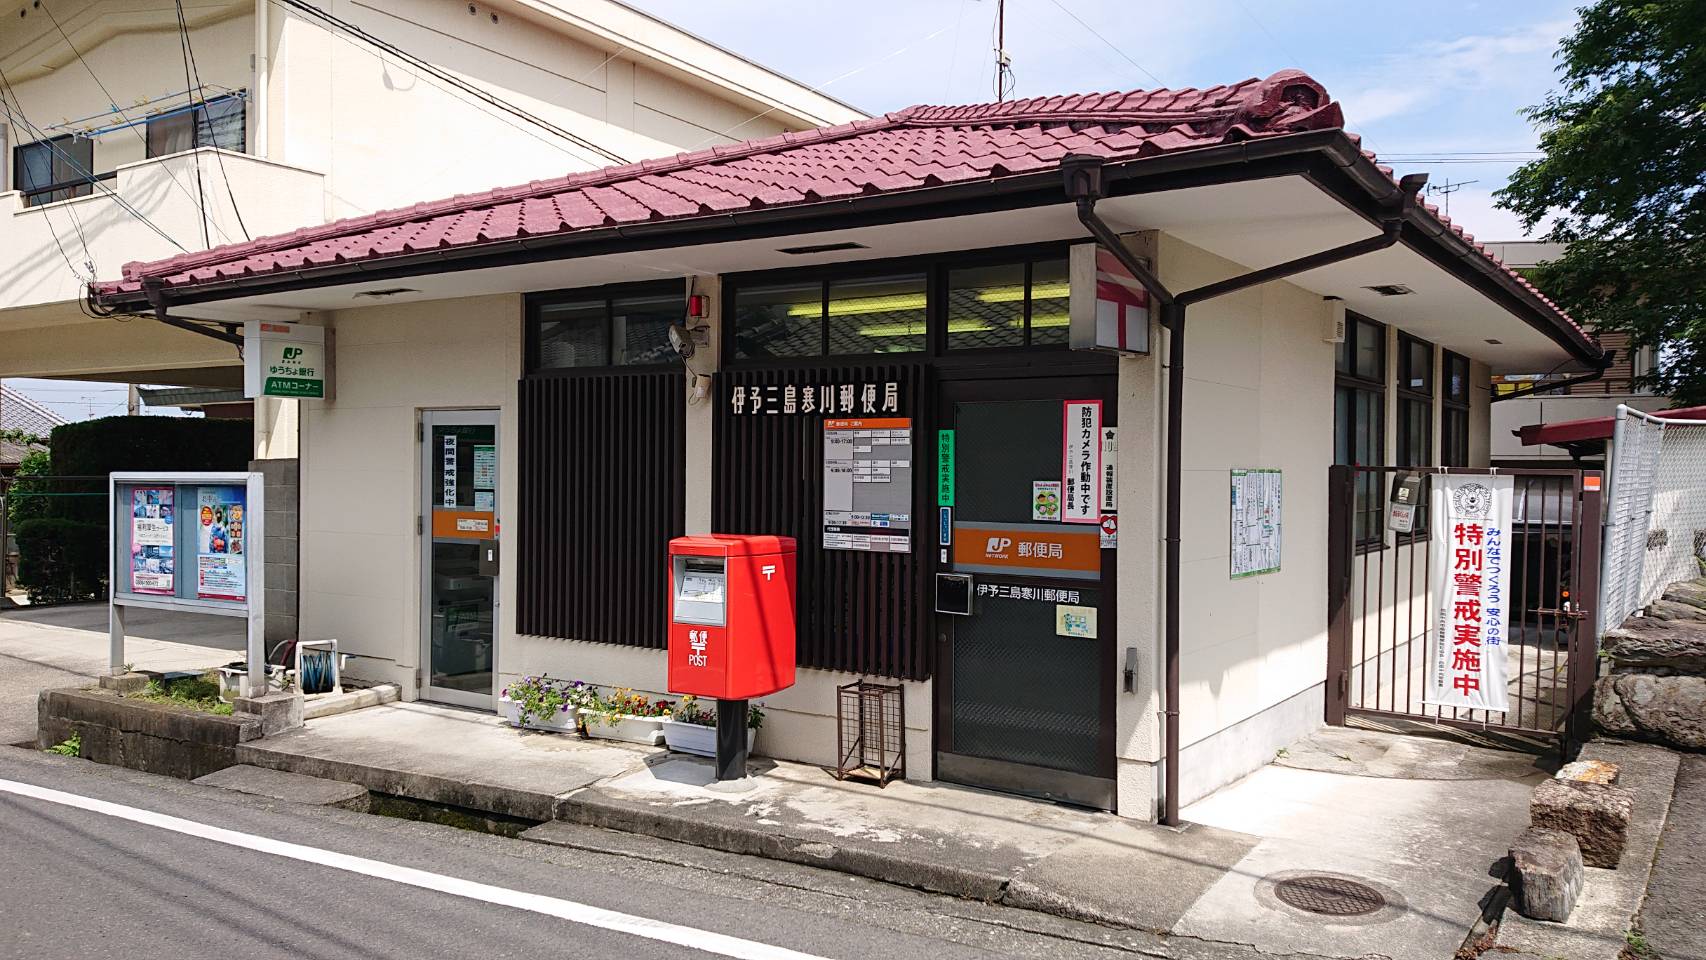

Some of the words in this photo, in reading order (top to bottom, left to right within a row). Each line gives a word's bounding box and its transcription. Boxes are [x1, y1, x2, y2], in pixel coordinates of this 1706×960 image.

[270, 366, 314, 377] ゆうちょ銀行
[271, 381, 319, 390] ATMコーナー
[731, 382, 899, 414] 伊予三島寒川郵便局
[445, 438, 456, 507] 夜間警戒強化中
[941, 432, 951, 503] 特別警戒実施中
[1080, 406, 1092, 516] 防犯カメラ作動中です
[1067, 478, 1075, 510] 郵便局長
[986, 537, 1012, 553] JP
[1018, 542, 1063, 559] 郵便局
[1486, 527, 1501, 603] みんなでつくろう
[977, 584, 1080, 604] 伊予三島寒川郵便局
[1452, 523, 1484, 697] 特別警戒実施中
[689, 630, 708, 644] 郵便
[1486, 608, 1501, 646] 安心の街
[689, 654, 707, 667] POST
